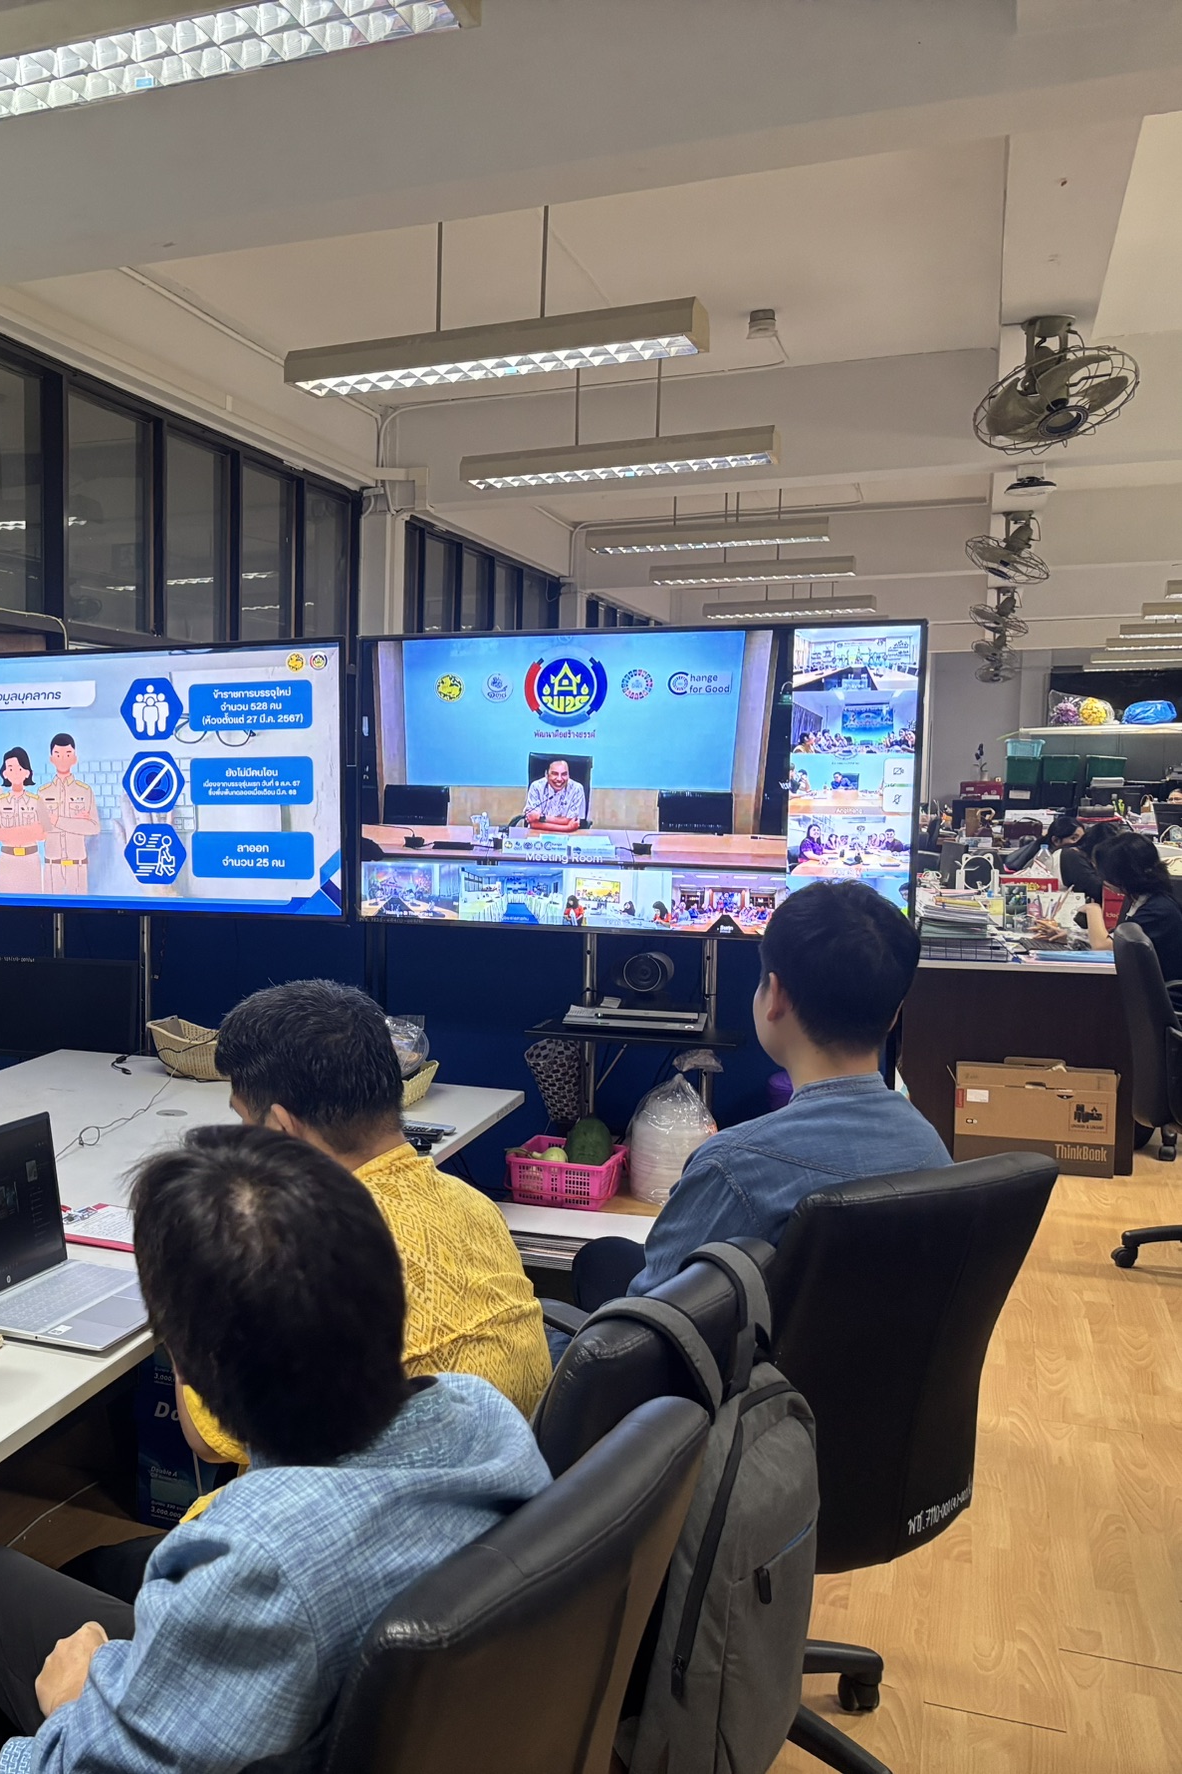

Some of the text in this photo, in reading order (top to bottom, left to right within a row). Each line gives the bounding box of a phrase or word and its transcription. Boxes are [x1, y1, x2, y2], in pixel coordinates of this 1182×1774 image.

[213, 686, 291, 699] ข้าราชการบรรจุใหม่
[689, 684, 730, 694] for Good
[220, 702, 282, 711] จำนวน 528 คน
[246, 714, 257, 724] 27
[277, 713, 304, 724] 2567)
[236, 844, 269, 853] ลาออก
[222, 856, 285, 867] จำนวน 25 คน
[525, 852, 603, 864] Meeting Room
[1054, 1143, 1108, 1162] ThinkBook
